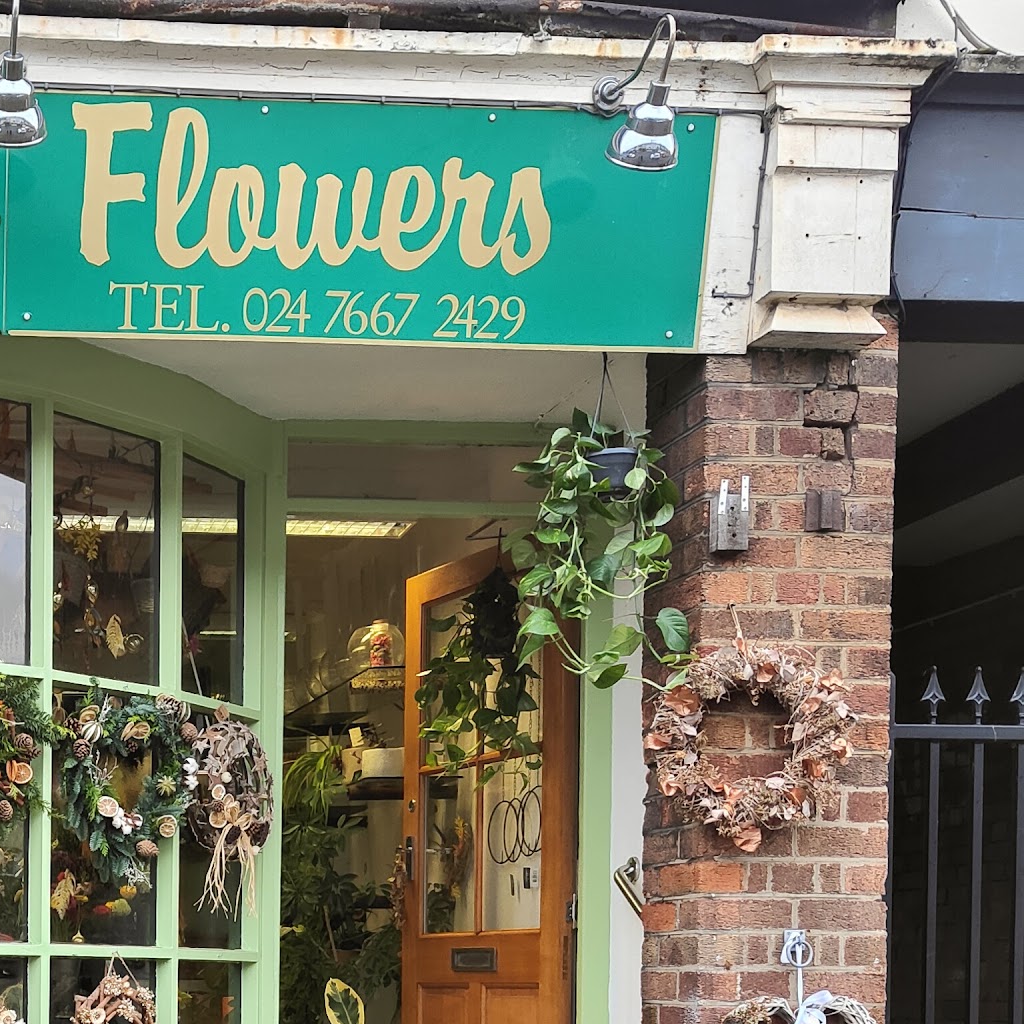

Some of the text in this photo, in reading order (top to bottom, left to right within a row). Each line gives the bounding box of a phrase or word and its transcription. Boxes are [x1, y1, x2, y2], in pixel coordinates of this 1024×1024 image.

[72, 101, 552, 275] Flowers
[108, 281, 526, 340] TEL. 024 7667 2429
